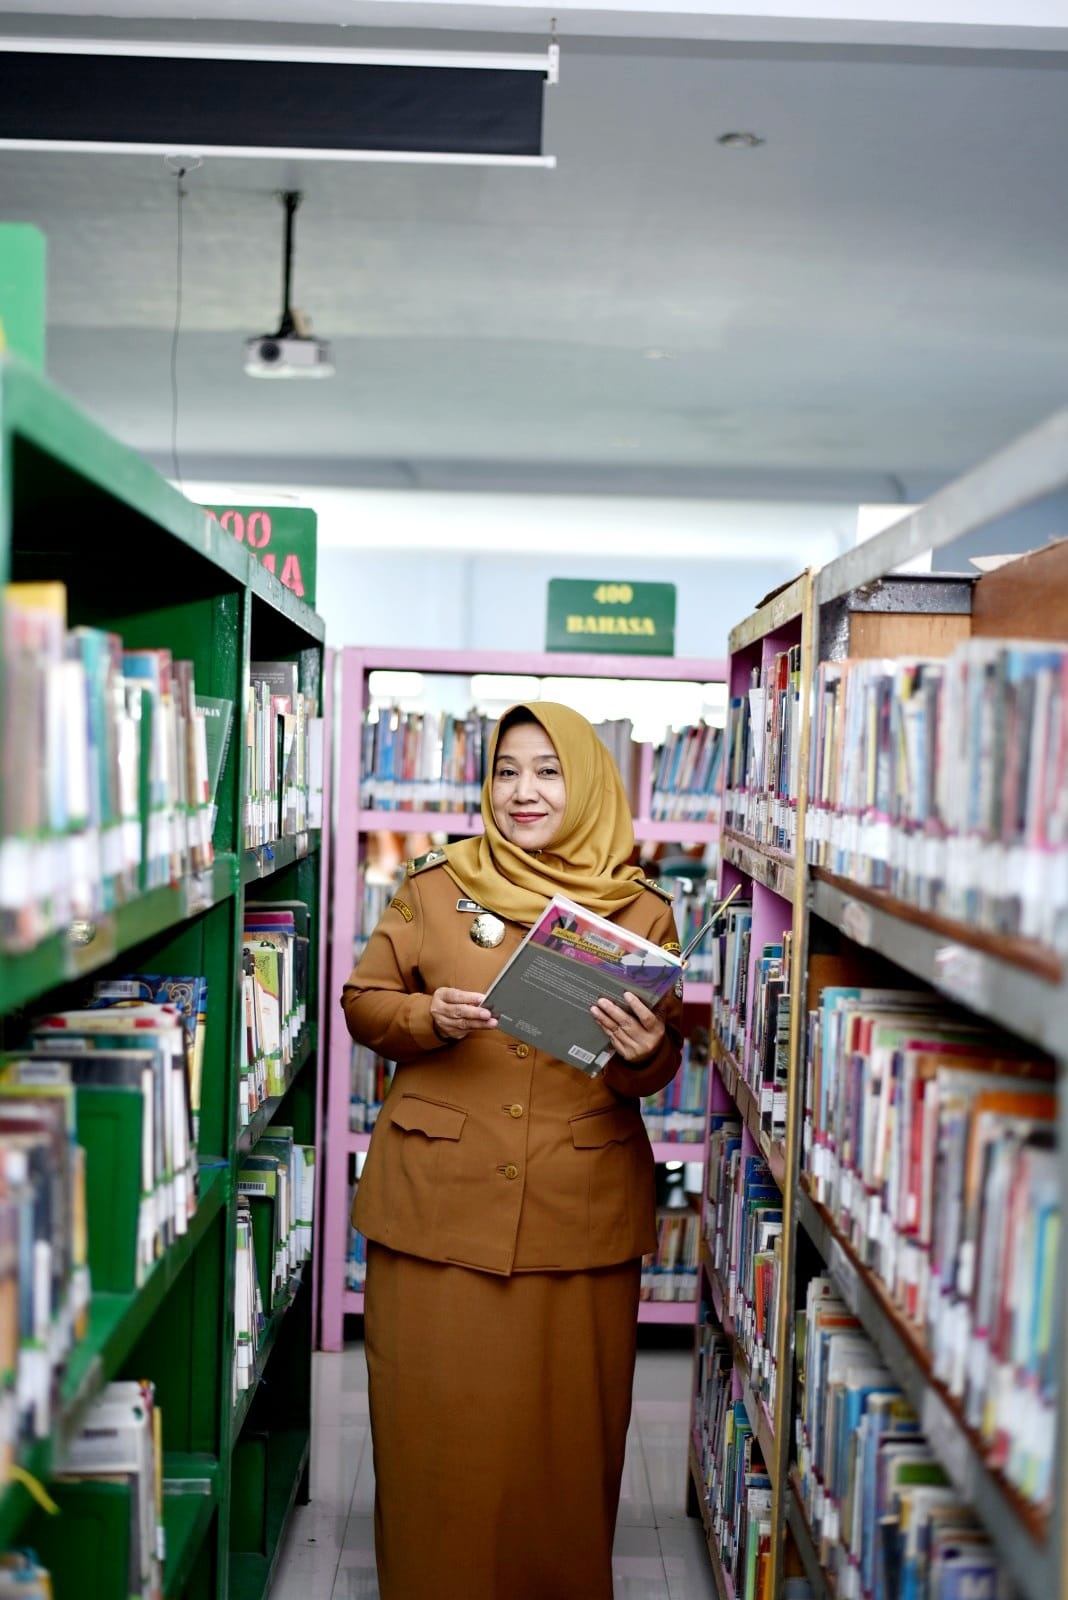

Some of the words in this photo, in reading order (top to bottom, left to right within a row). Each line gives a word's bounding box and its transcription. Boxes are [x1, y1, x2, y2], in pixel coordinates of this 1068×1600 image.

[203, 509, 271, 549] 00
[593, 583, 633, 604] 400
[566, 614, 655, 635] BAHASA
